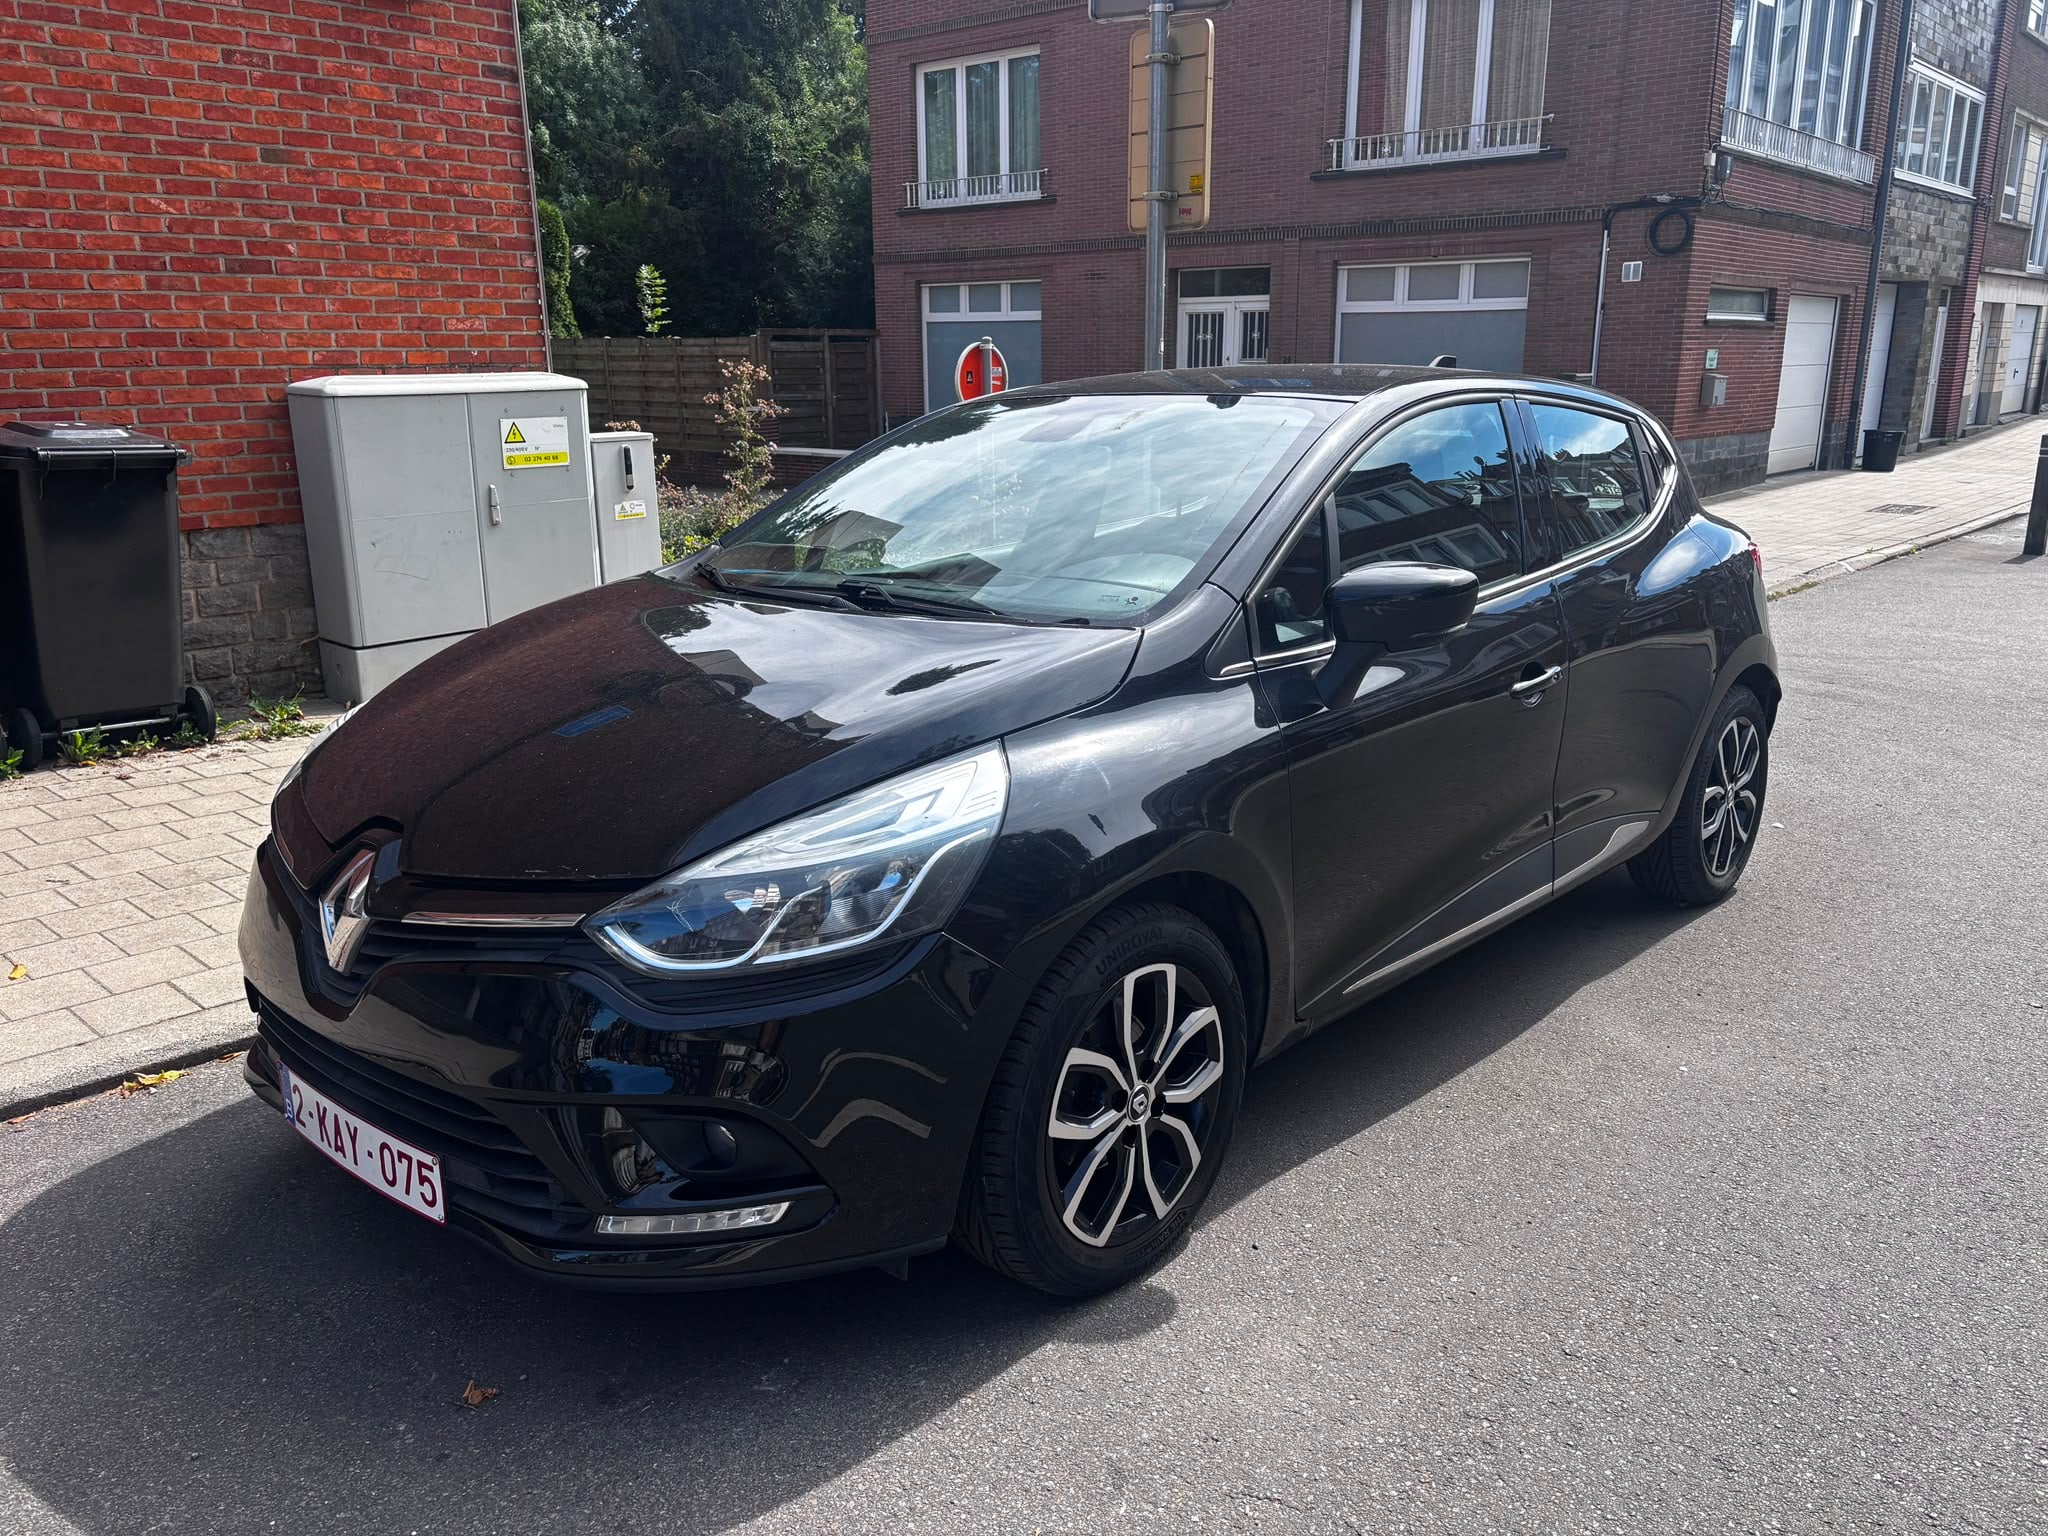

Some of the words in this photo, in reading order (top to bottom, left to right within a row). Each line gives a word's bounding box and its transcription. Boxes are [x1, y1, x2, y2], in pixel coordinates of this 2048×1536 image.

[1095, 927, 1167, 975] UNIROYAL
[285, 1098, 294, 1118] B
[292, 1083, 438, 1208] 2-KAY-075
